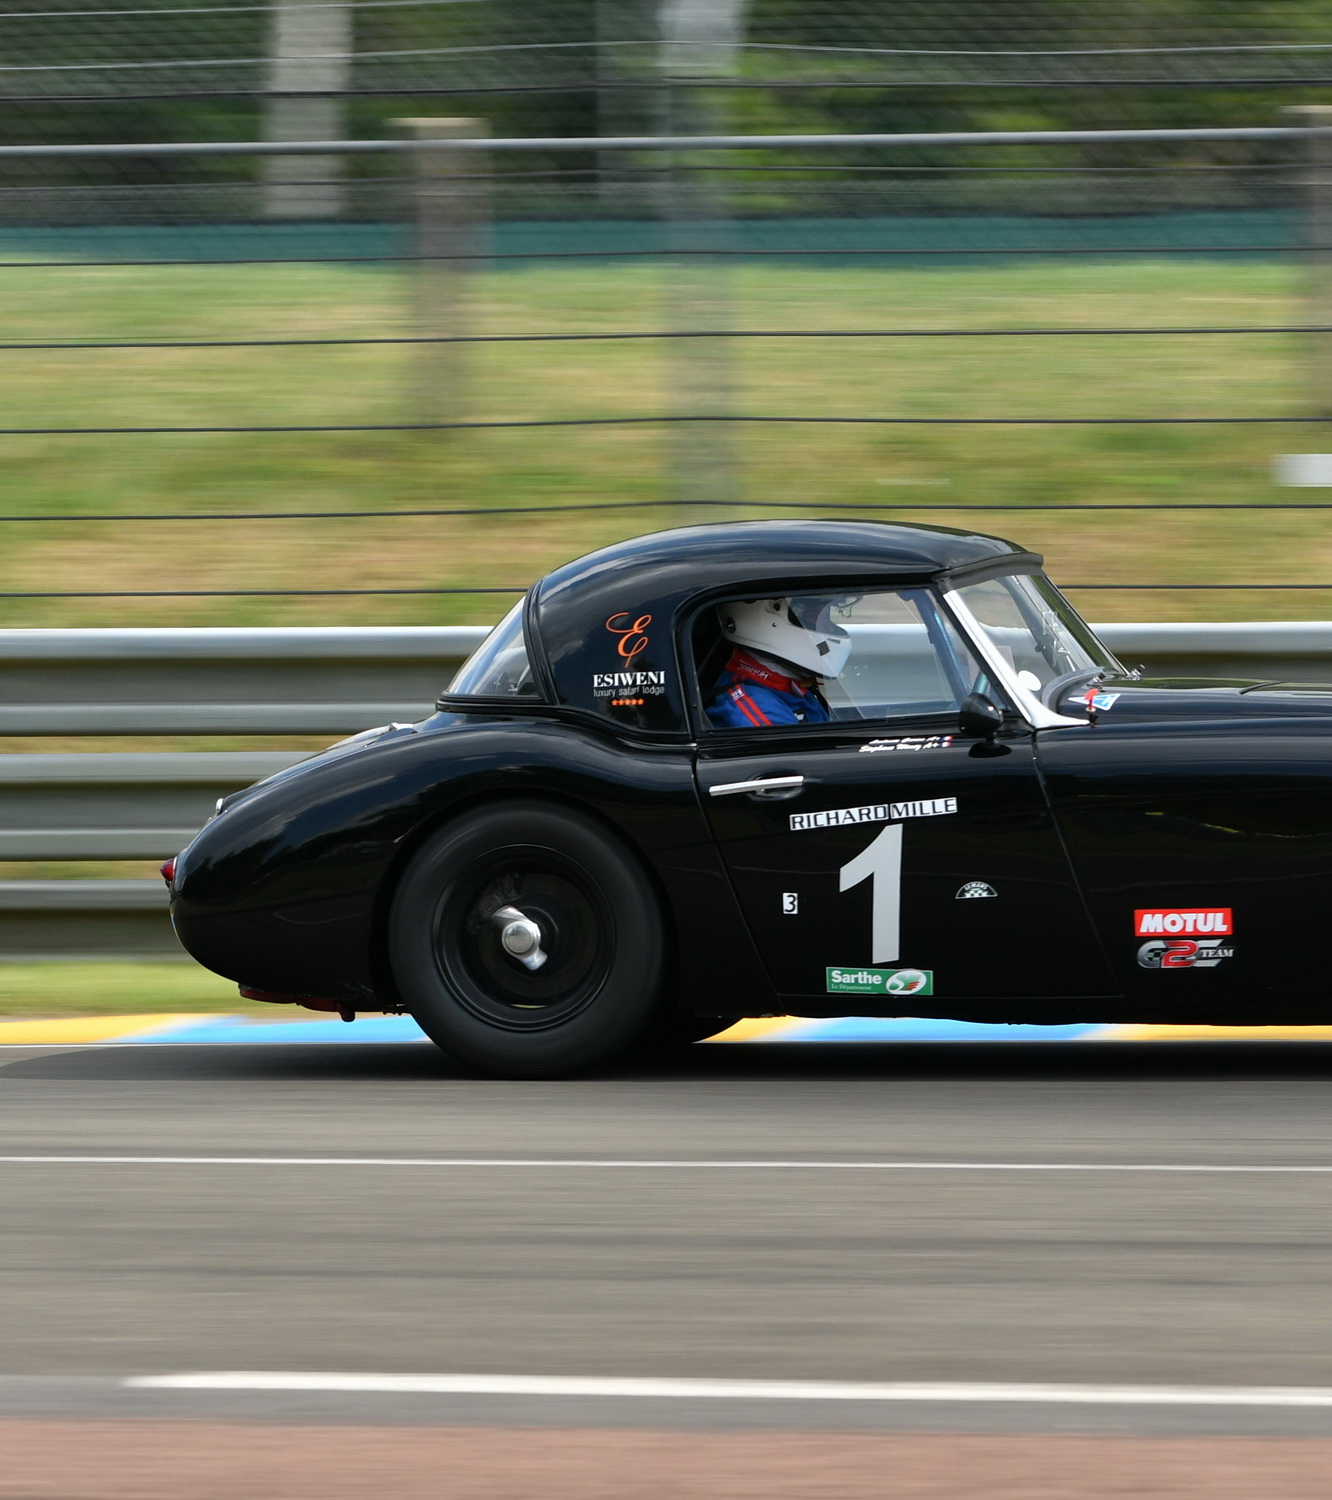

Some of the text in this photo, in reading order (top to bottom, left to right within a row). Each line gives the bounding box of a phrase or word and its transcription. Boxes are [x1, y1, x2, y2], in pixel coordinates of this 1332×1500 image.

[592, 670, 666, 688] ESIWENI
[593, 688, 616, 698] luxury
[642, 685, 665, 696] lodge
[791, 798, 957, 830] RICHARD MILLE
[839, 823, 903, 964] 1
[785, 894, 796, 913] 3
[1139, 912, 1228, 933] MOTUL
[1200, 949, 1234, 958] TEAM
[831, 970, 882, 984] Sarthe
